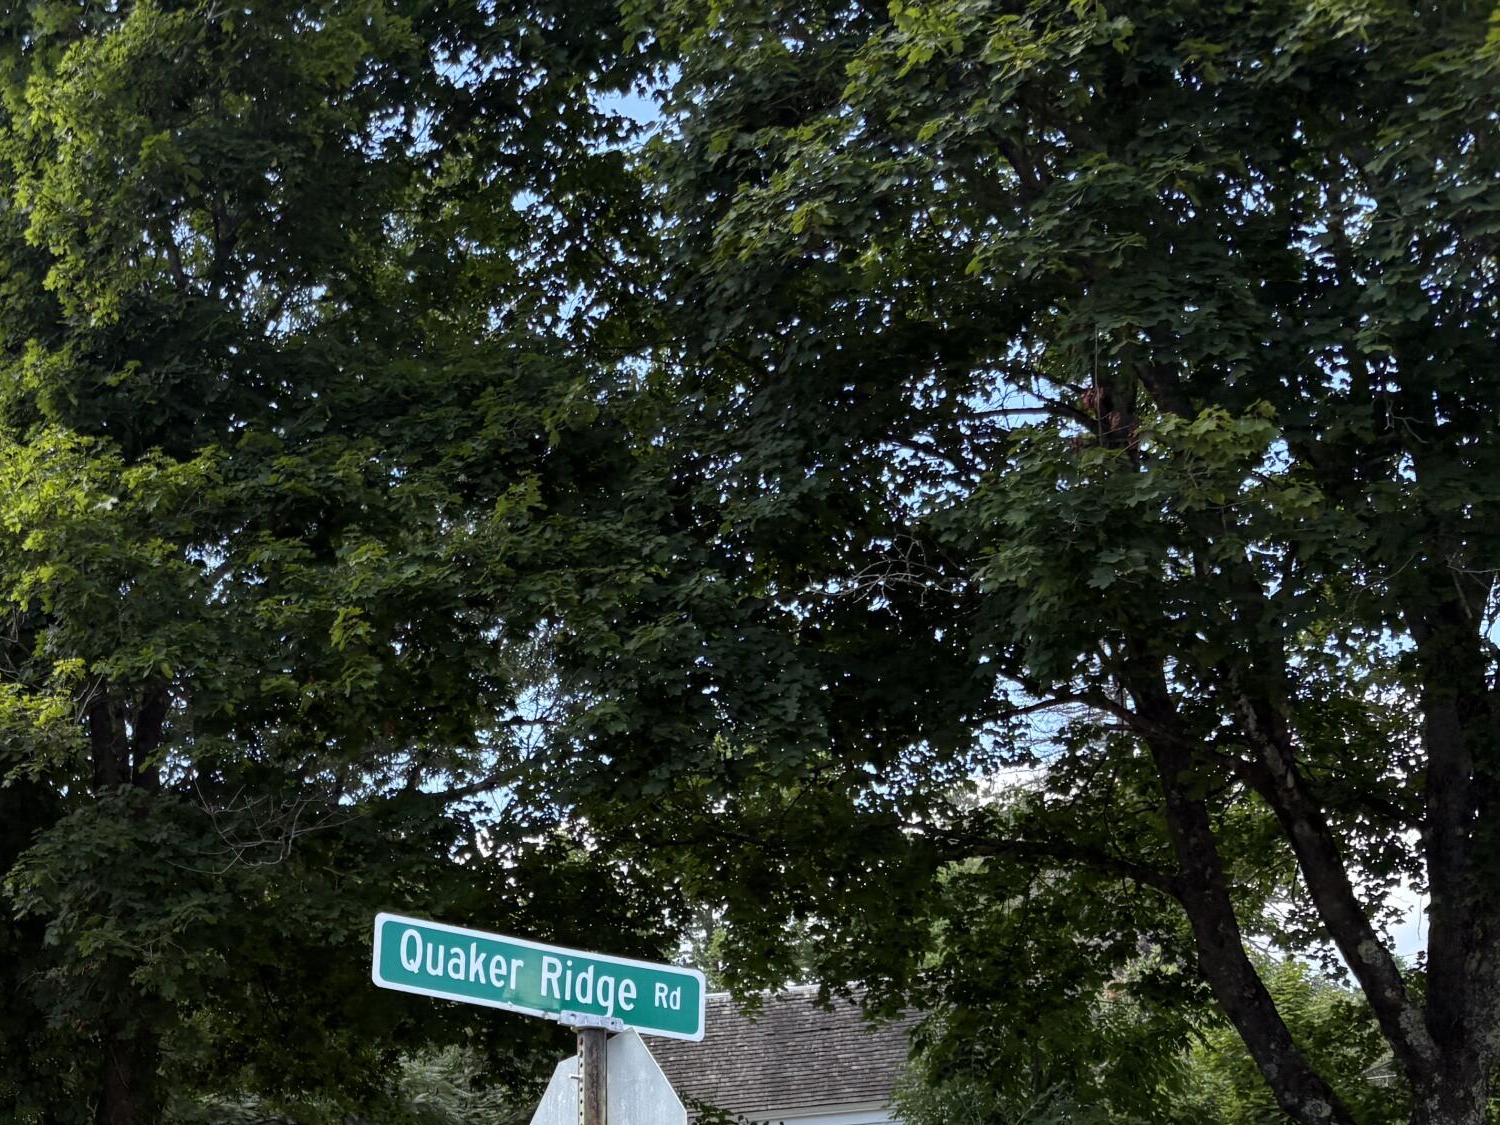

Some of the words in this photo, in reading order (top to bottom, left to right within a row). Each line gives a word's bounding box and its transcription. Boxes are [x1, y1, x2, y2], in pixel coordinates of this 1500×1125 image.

[400, 928, 524, 990] Quaker
[540, 955, 637, 1018] Ridge
[654, 982, 681, 1011] Rd
